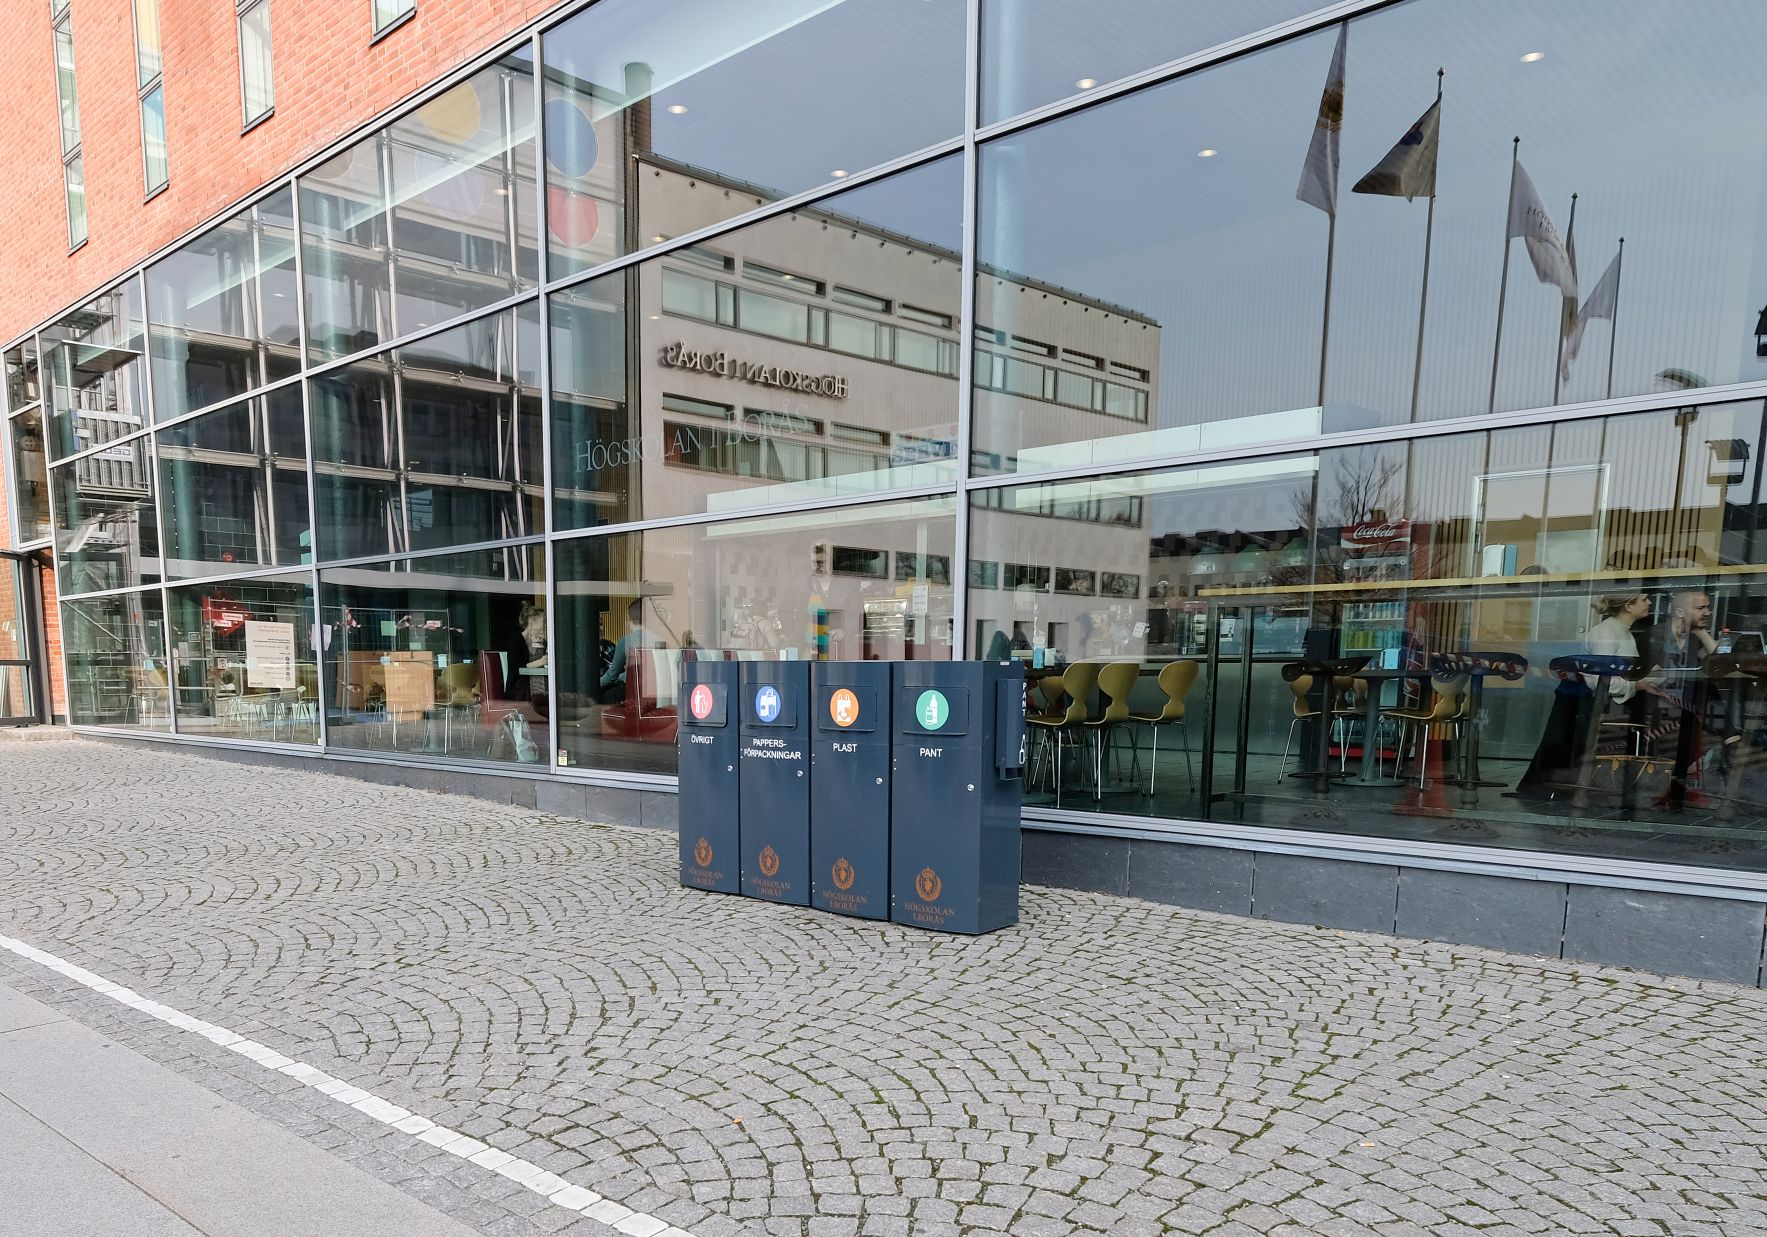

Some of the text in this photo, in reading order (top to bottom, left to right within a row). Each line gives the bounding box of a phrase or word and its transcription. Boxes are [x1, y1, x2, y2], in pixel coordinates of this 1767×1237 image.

[690, 733, 715, 745] ÖVRIGT
[752, 738, 788, 748] PAPPERS-
[832, 742, 858, 753] PLAST
[919, 747, 943, 758] PANT
[743, 747, 802, 760] FÖRPACKNINGAR
